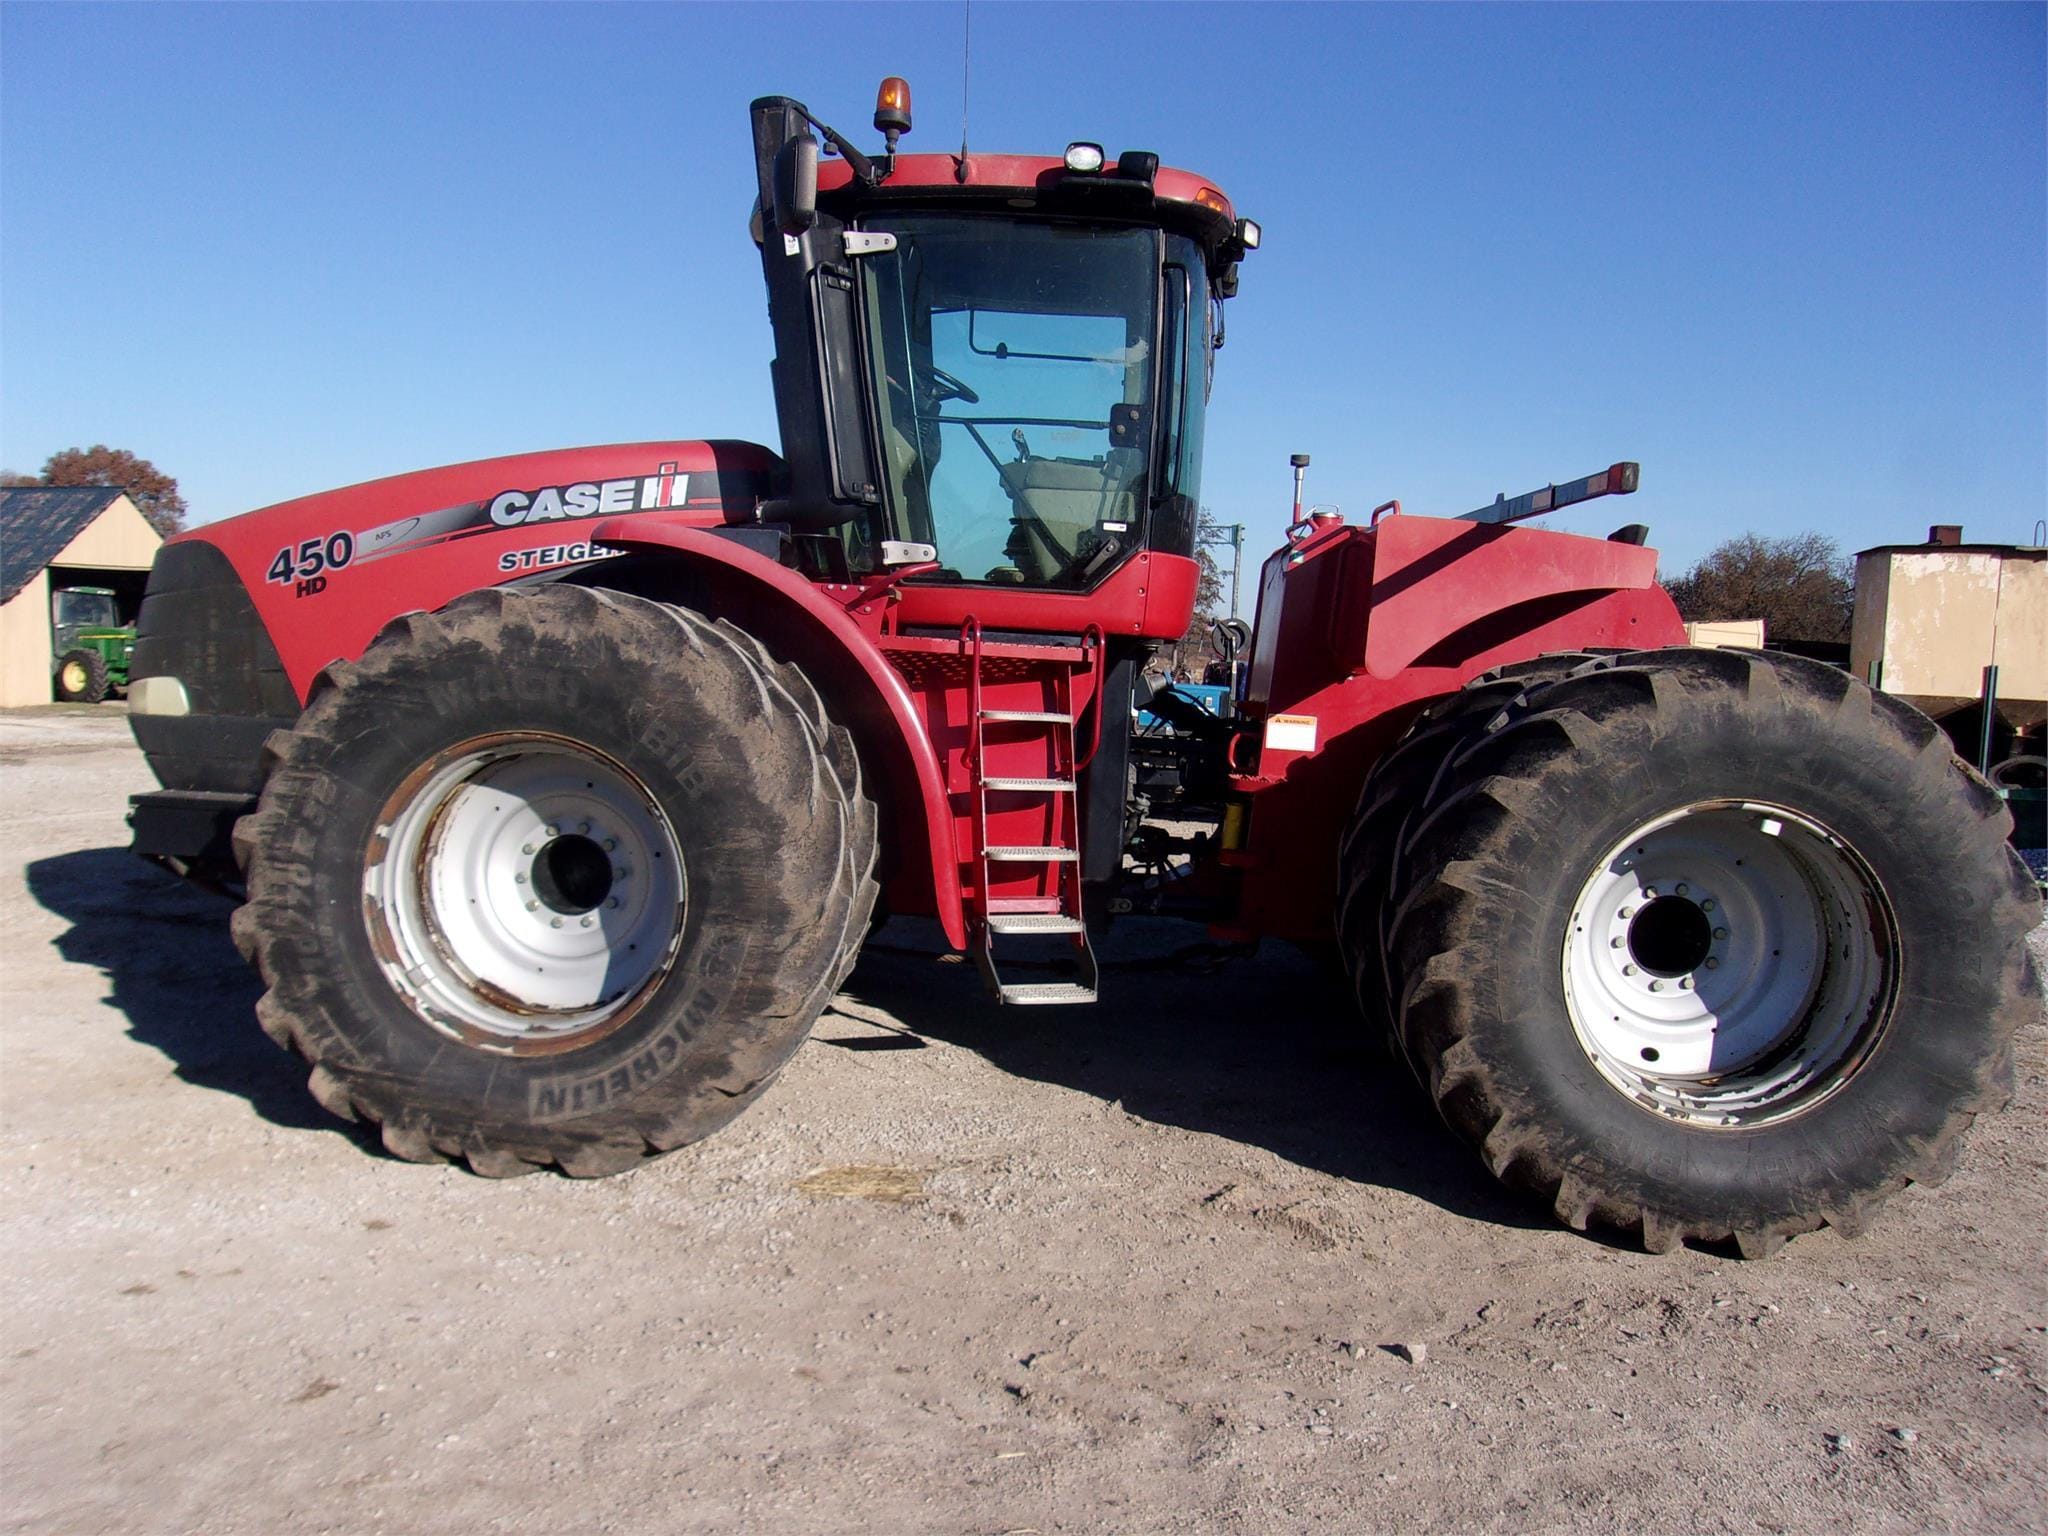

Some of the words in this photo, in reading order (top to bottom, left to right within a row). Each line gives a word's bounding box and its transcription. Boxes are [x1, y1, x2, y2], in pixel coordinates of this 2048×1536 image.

[489, 479, 637, 526] CASE
[266, 531, 354, 584] 450
[295, 576, 328, 599] HD
[534, 987, 721, 1118] MICHELIN
